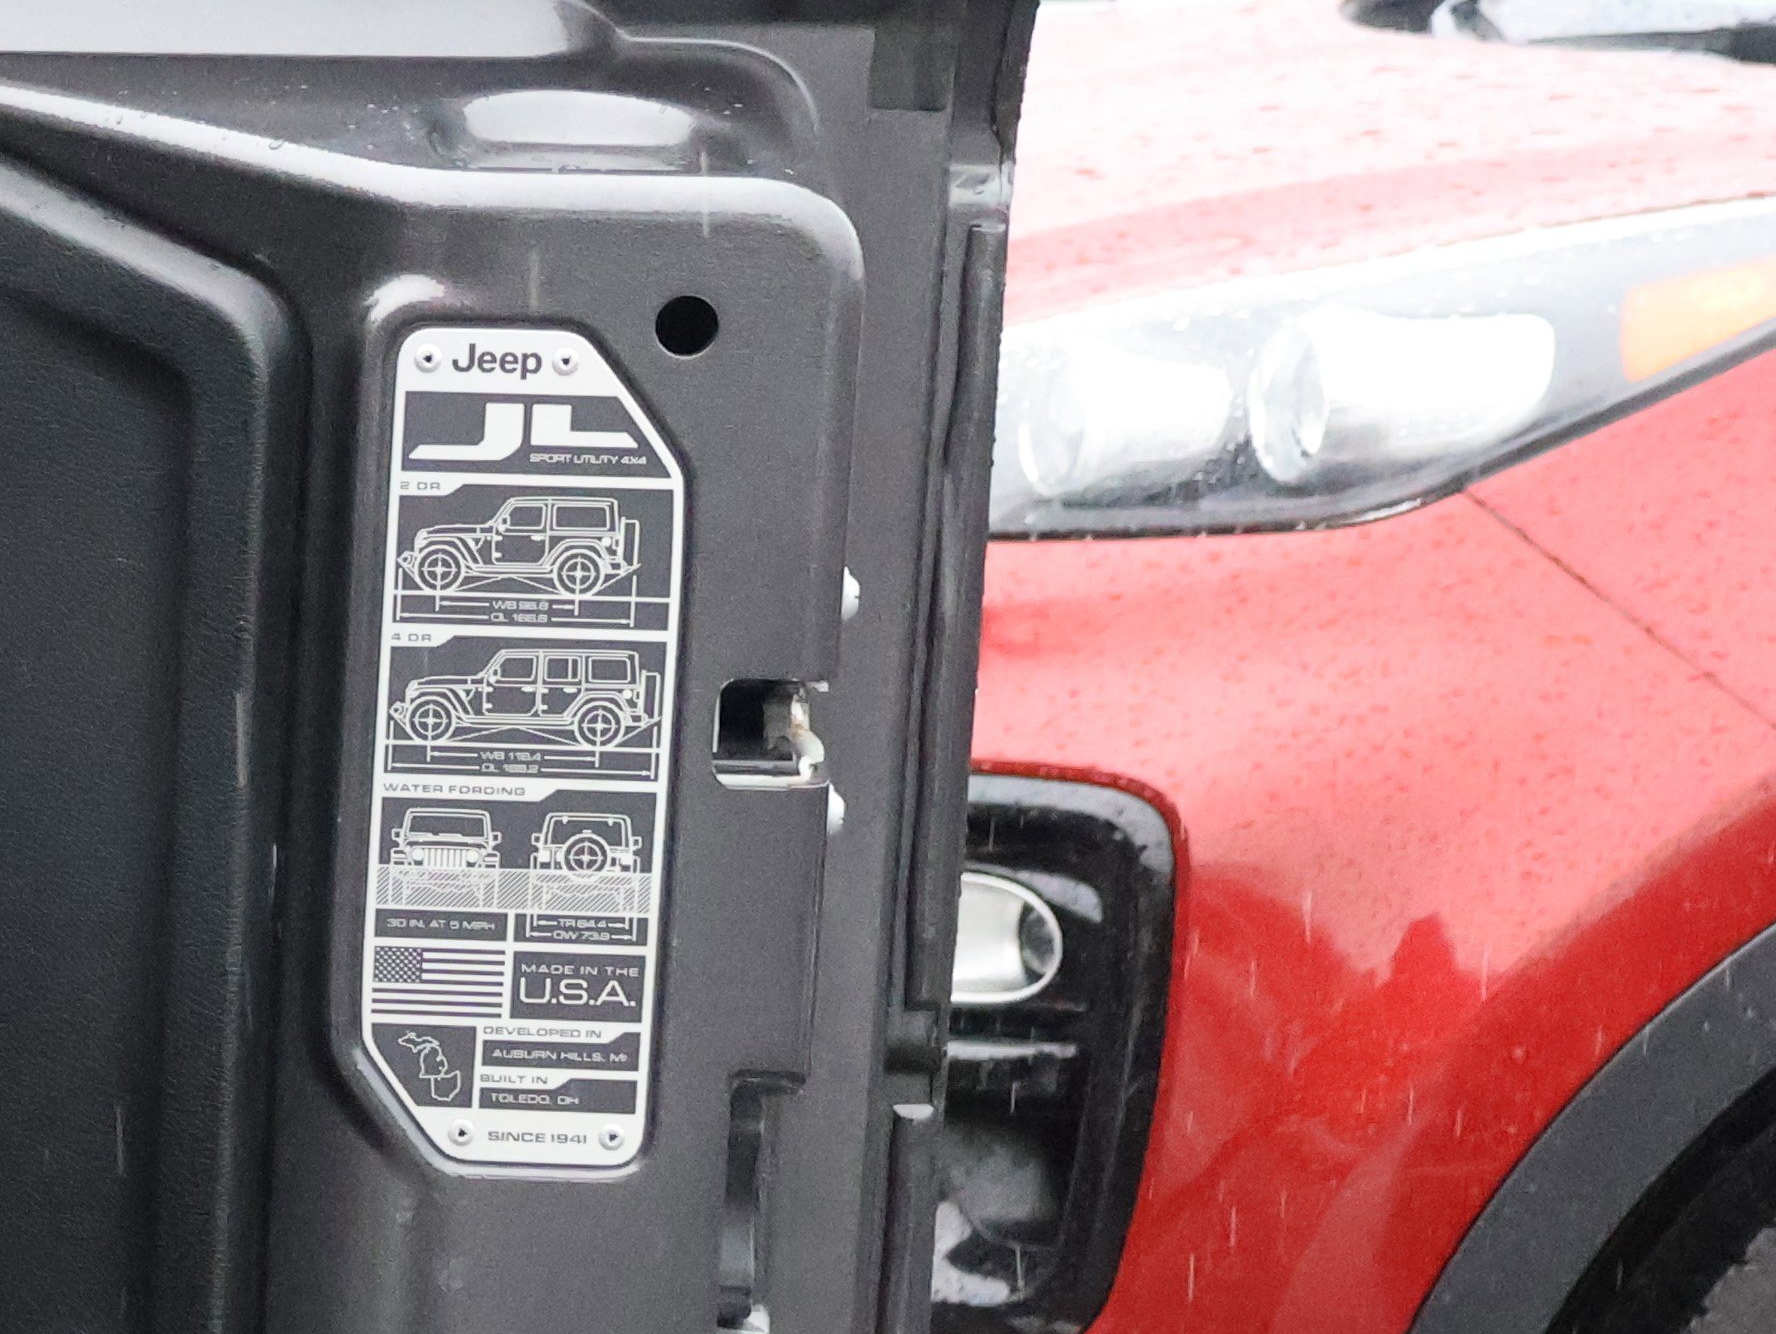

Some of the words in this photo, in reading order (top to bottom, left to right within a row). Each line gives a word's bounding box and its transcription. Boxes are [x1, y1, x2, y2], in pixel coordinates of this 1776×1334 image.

[451, 343, 543, 381] Jeep
[408, 401, 639, 461] JL
[529, 452, 572, 464] SPORT
[573, 453, 619, 465] UTILITY
[400, 481, 410, 491] 2
[390, 633, 401, 642] 4
[407, 633, 432, 643] DR
[382, 782, 444, 794] WATER
[447, 785, 527, 797] FORDING
[386, 917, 407, 929] 30
[429, 918, 447, 929] AT
[449, 919, 460, 930] 5
[461, 919, 496, 932] MPH
[521, 963, 575, 976] MADE
[579, 965, 599, 976] IN
[604, 965, 640, 978] THE
[519, 976, 637, 1007] U.S.A.
[483, 1025, 582, 1039] DEVELOPED
[585, 1029, 603, 1039] IN
[491, 1048, 558, 1061] AUBURN
[479, 1073, 527, 1085] BUILT
[531, 1075, 549, 1085] IN
[556, 1094, 581, 1107] OH
[487, 1130, 547, 1144] SINCE
[550, 1132, 589, 1146] 1941
